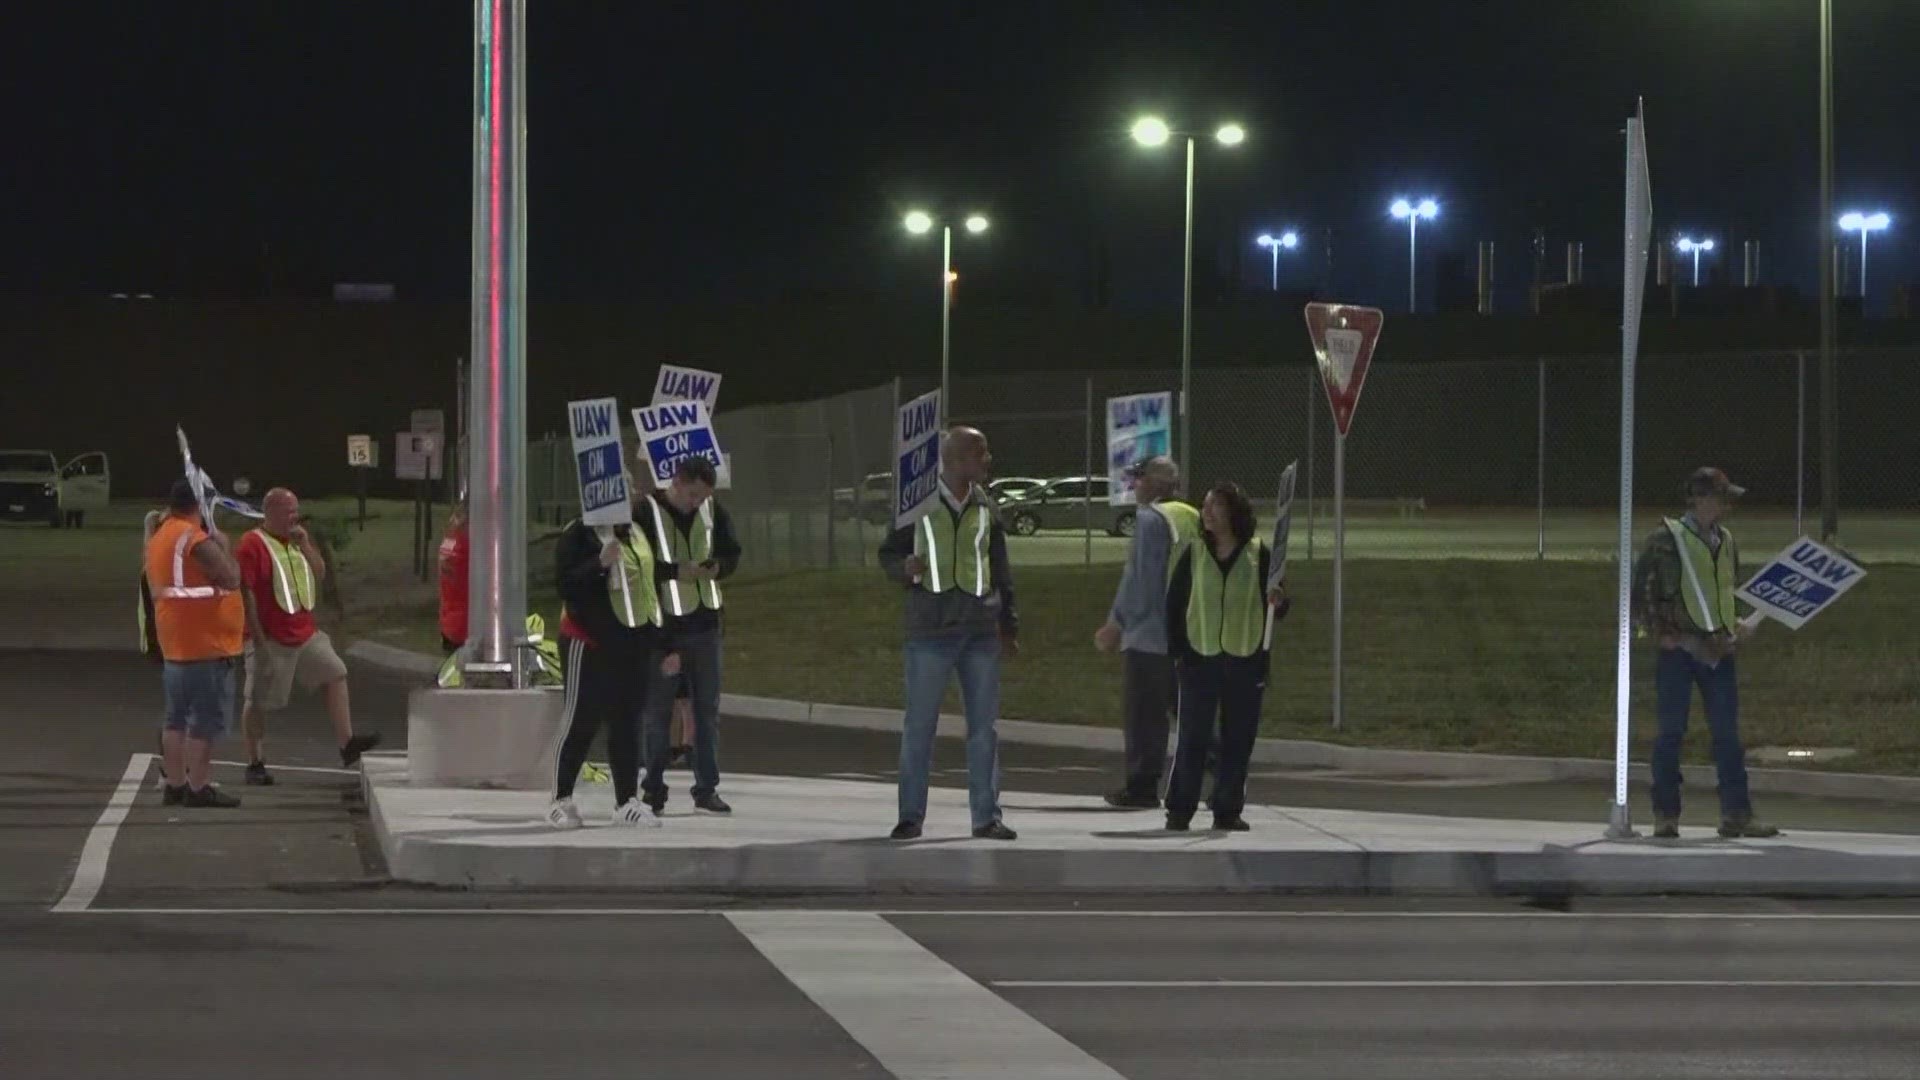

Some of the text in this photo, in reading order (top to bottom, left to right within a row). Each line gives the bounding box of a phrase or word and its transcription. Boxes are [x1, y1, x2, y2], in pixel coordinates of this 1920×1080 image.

[661, 370, 715, 401] UAW
[573, 404, 612, 439] UAW
[639, 403, 698, 433] UAW
[903, 394, 938, 441] UAW
[352, 449, 367, 461] 15
[665, 432, 689, 455] ON
[588, 449, 605, 478] ON
[658, 447, 715, 479] STE
[911, 444, 929, 476] ON
[584, 475, 624, 509] STRIKE
[901, 464, 938, 511] STRIKE
[1790, 542, 1858, 585] UAW
[1750, 580, 1819, 617] STRIKE
[1780, 573, 1816, 595] ON
